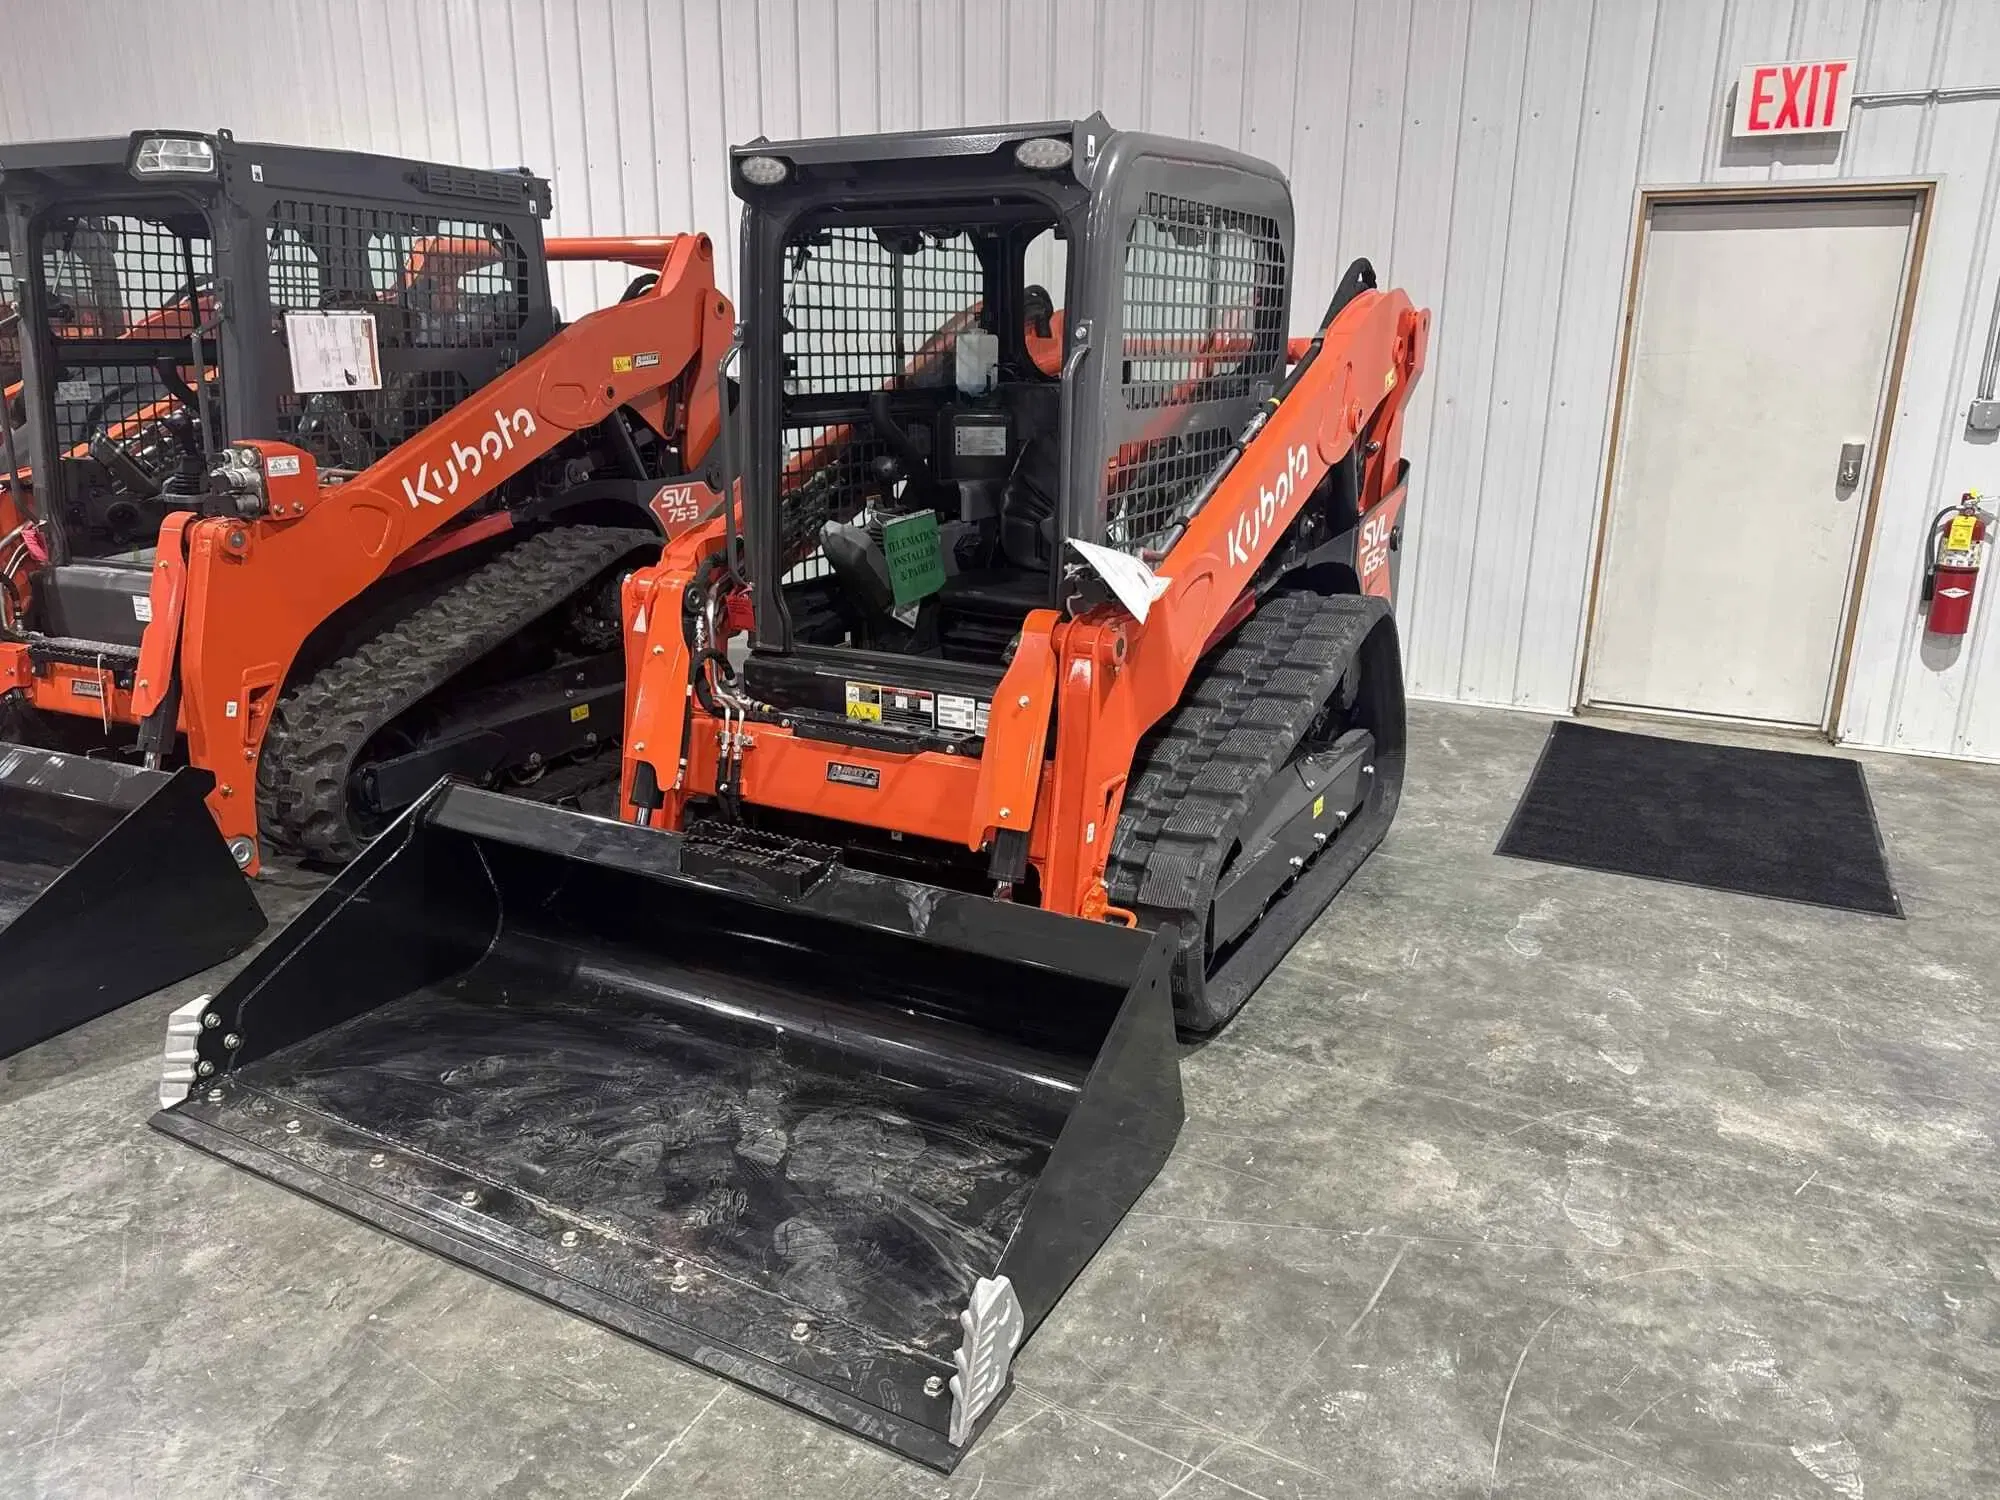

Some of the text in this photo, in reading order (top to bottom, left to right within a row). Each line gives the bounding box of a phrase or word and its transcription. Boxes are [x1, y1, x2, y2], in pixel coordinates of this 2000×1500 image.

[1748, 63, 1848, 130] EXIT
[401, 408, 537, 509] Kubota
[661, 487, 697, 508] SVL
[1227, 444, 1309, 568] Kubota
[1360, 514, 1390, 554] SVL
